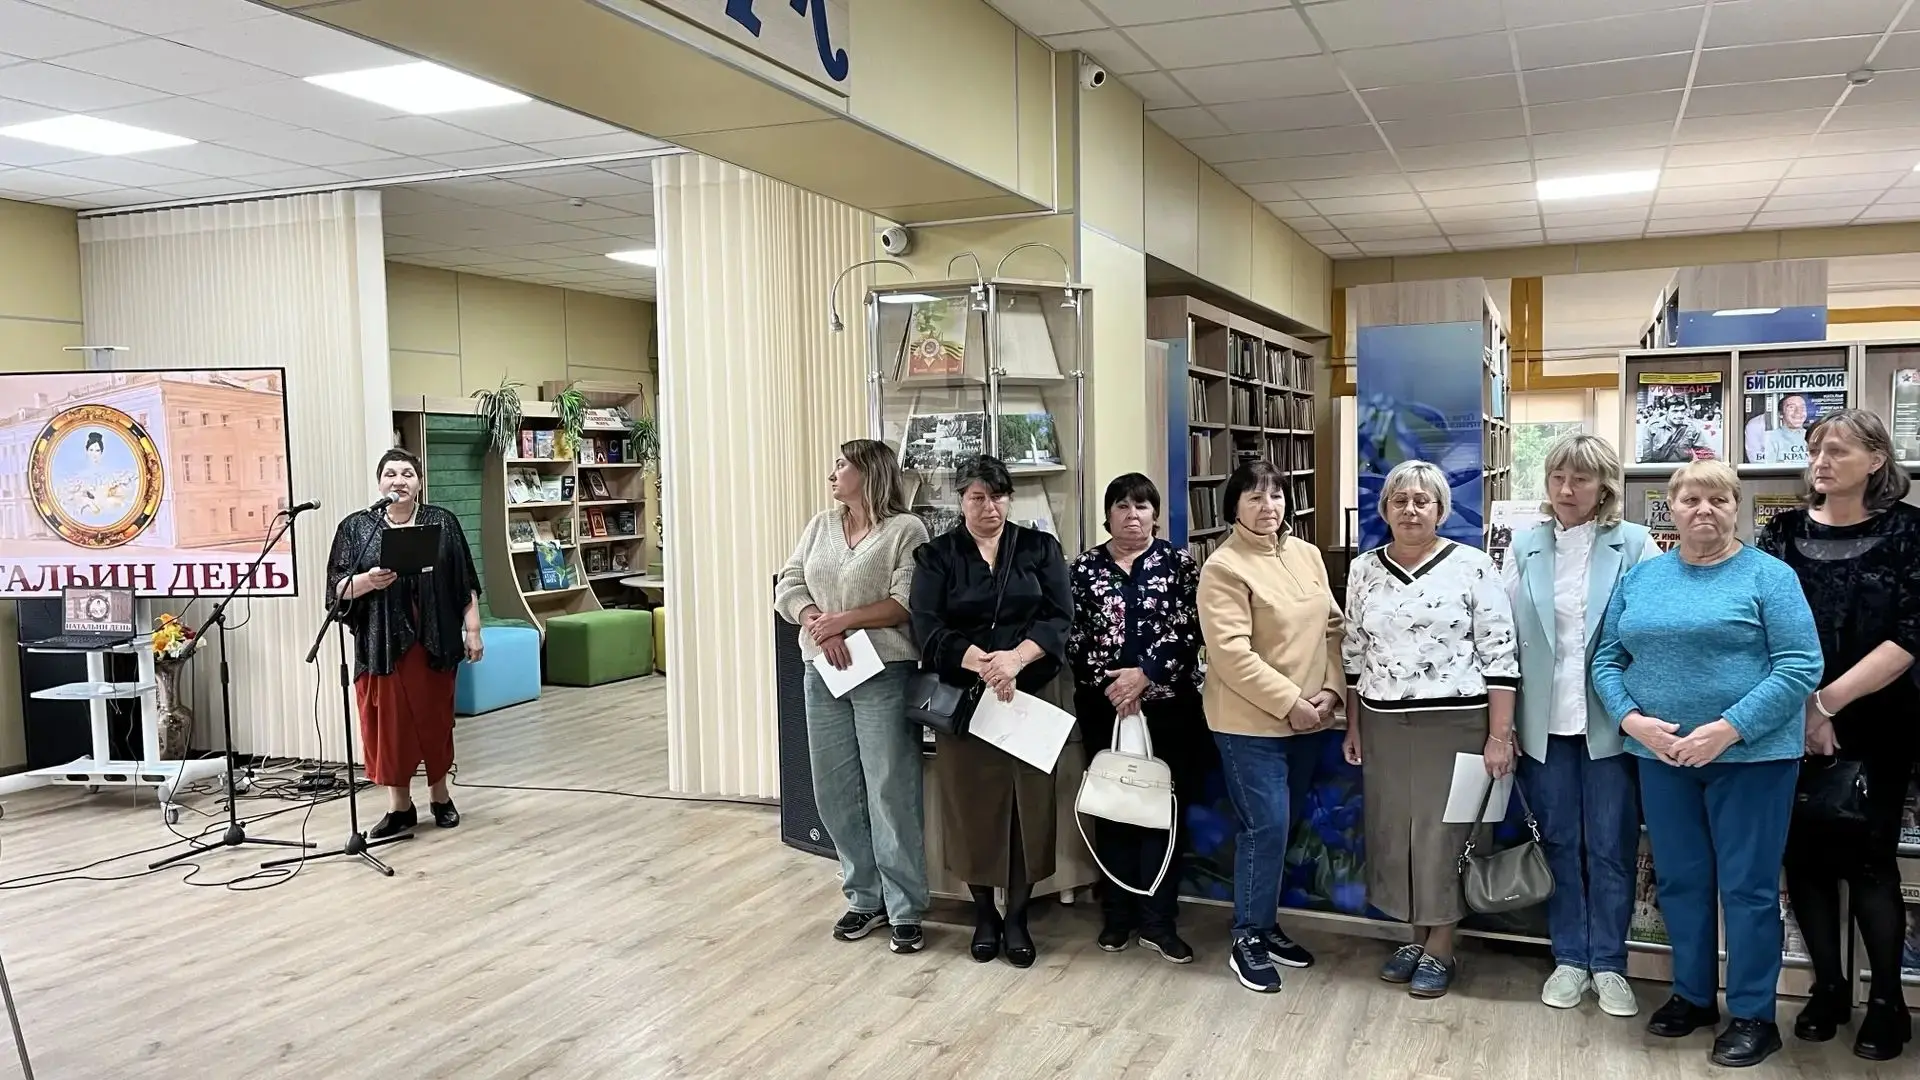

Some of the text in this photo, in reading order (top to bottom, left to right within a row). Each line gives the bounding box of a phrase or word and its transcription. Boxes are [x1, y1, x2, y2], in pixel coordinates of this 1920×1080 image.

[1746, 376, 1766, 390] БИ
[1767, 373, 1845, 389] БИОГРАФИЯ
[168, 562, 289, 597] ДЕНЬ
[66, 623, 108, 631] НАТАЛЬИН
